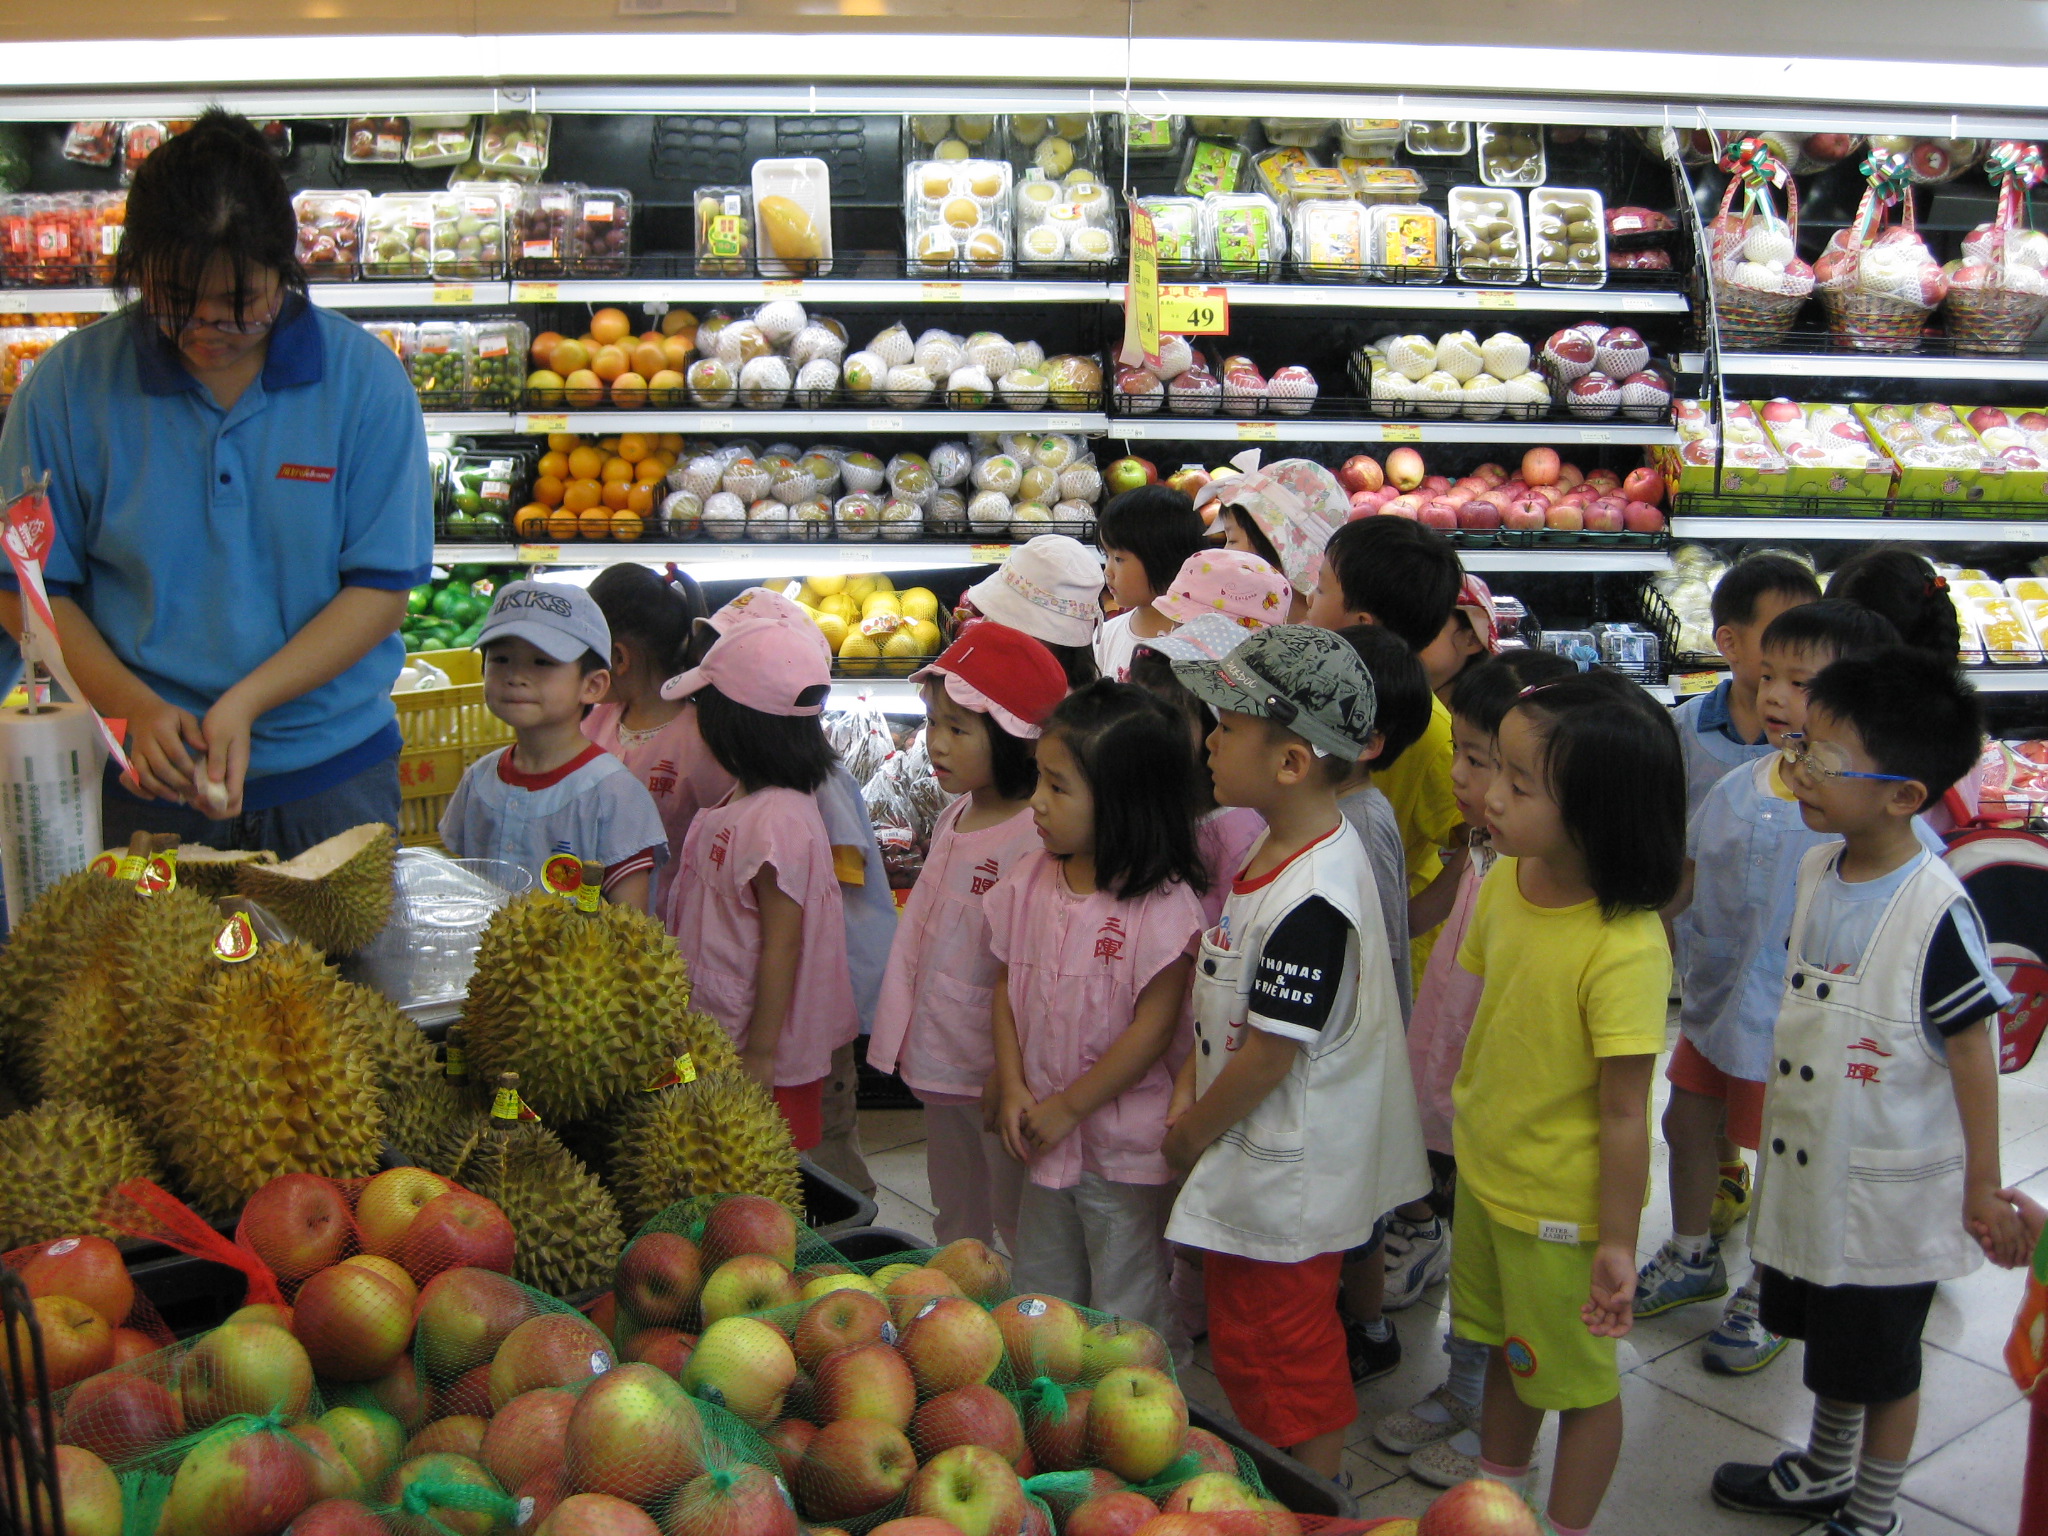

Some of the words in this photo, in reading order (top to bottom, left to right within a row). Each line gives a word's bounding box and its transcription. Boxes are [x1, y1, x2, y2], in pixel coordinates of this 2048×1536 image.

[1187, 308, 1215, 327] 49
[1259, 956, 1323, 981] THOMAS
[1275, 974, 1286, 986] &
[1254, 978, 1314, 1005] FRIENDS
